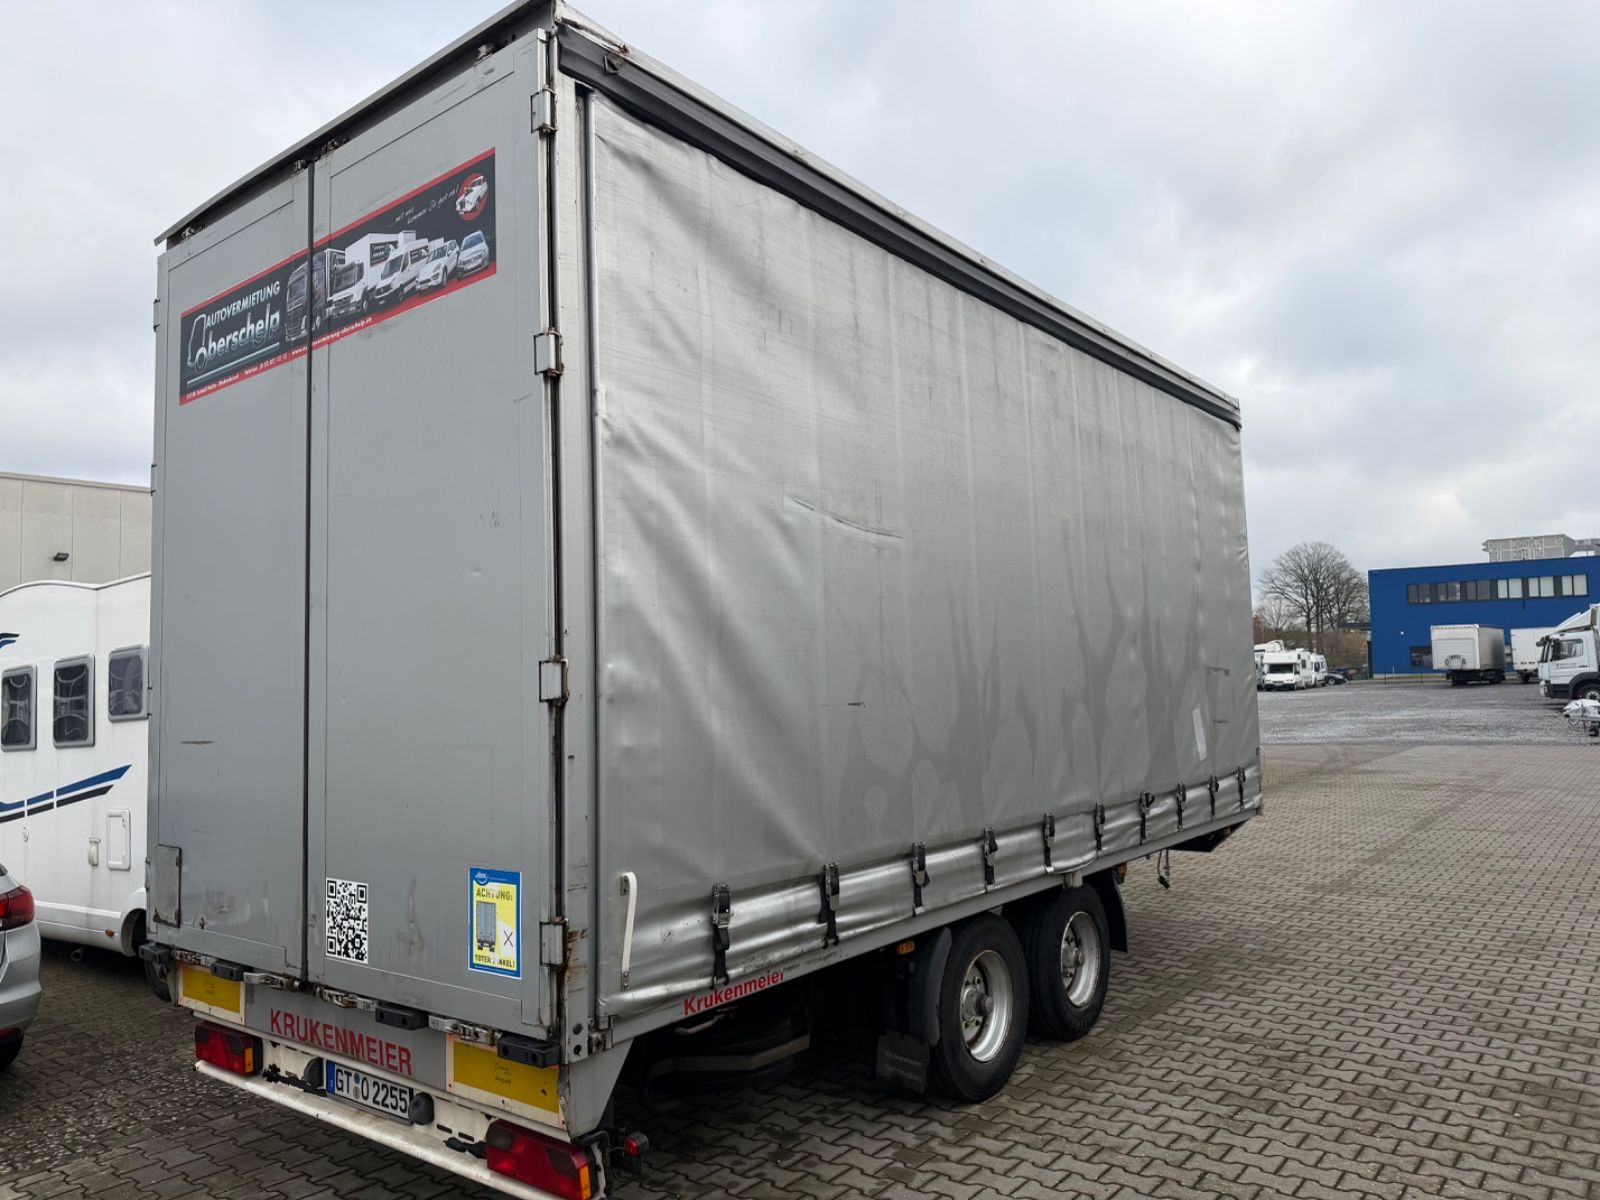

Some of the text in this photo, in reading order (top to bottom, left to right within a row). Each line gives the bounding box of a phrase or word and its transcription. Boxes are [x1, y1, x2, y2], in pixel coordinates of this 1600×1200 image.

[205, 280, 280, 329] AUTOVERMIETUNG
[683, 970, 784, 1017] Krukenmeier
[269, 1007, 413, 1077] KRUKENMEIER
[335, 1068, 353, 1096] GT
[372, 1080, 409, 1114] 2255
